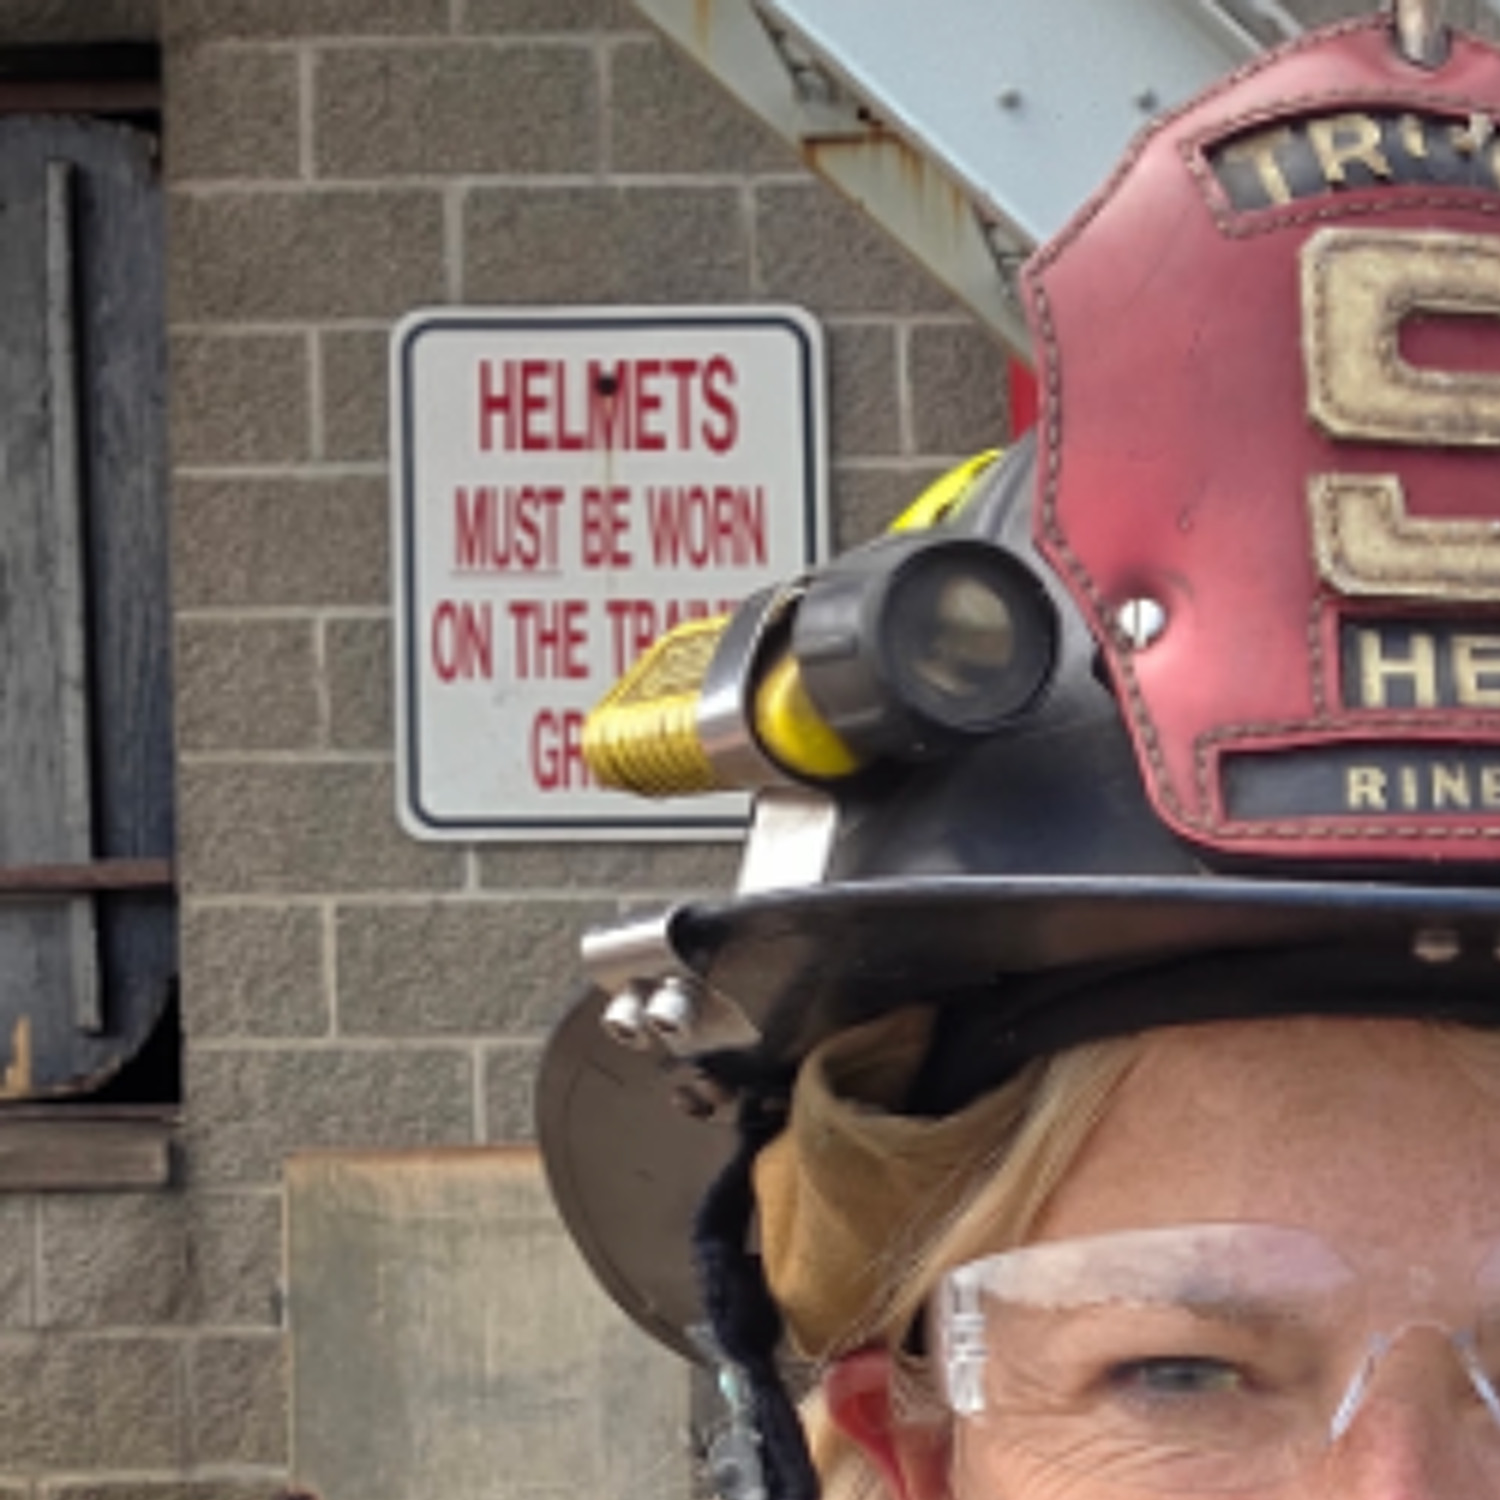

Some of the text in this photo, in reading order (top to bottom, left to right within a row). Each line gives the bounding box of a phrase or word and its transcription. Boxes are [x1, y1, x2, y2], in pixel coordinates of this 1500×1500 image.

[479, 356, 739, 453] HELMETS
[454, 485, 768, 568] MUST BE WORN
[430, 600, 493, 682] ON
[510, 600, 589, 681] THE
